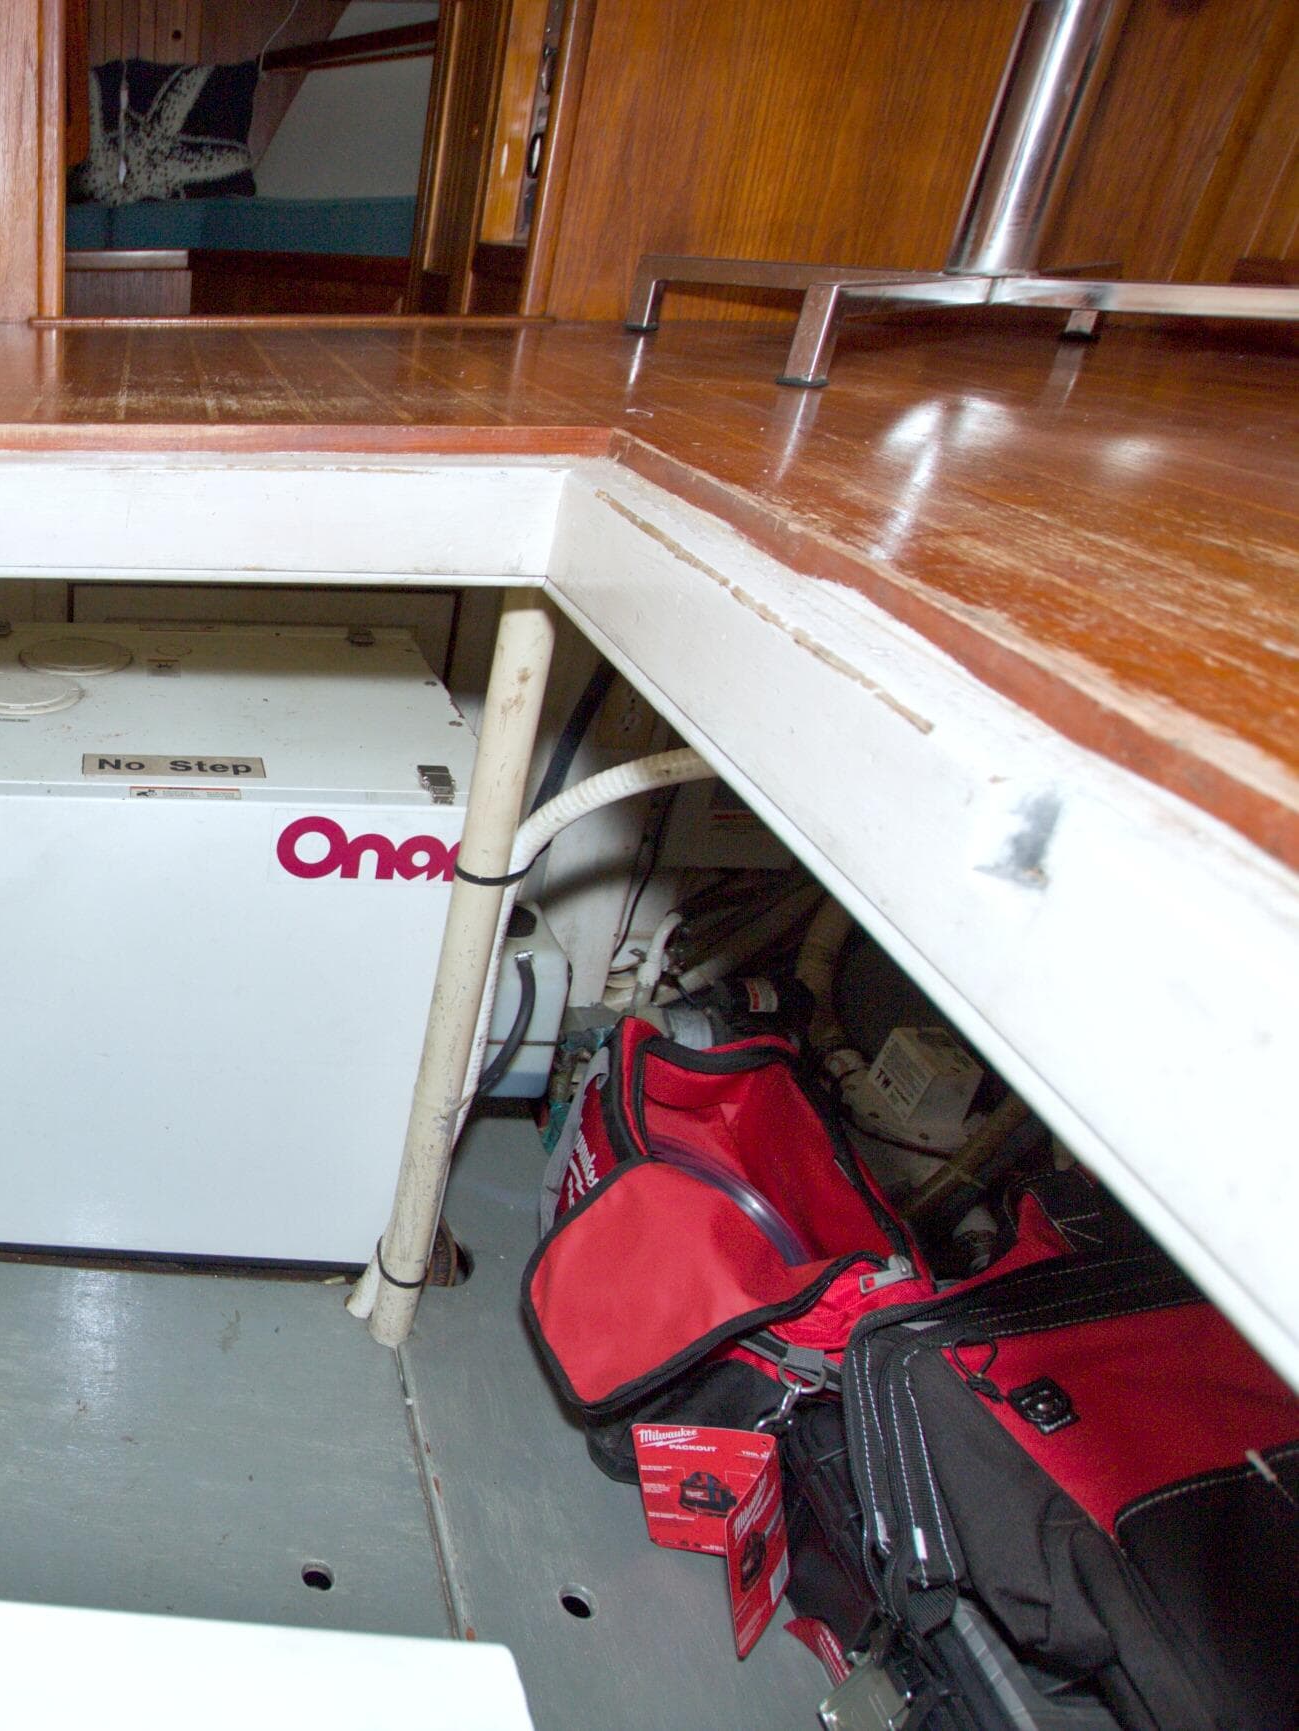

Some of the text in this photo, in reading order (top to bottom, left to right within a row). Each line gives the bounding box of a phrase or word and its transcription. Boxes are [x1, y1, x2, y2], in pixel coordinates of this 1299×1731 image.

[98, 758, 252, 775] No Step
[637, 1428, 698, 1444] Milwaukee
[669, 1444, 718, 1453] PACKOUT
